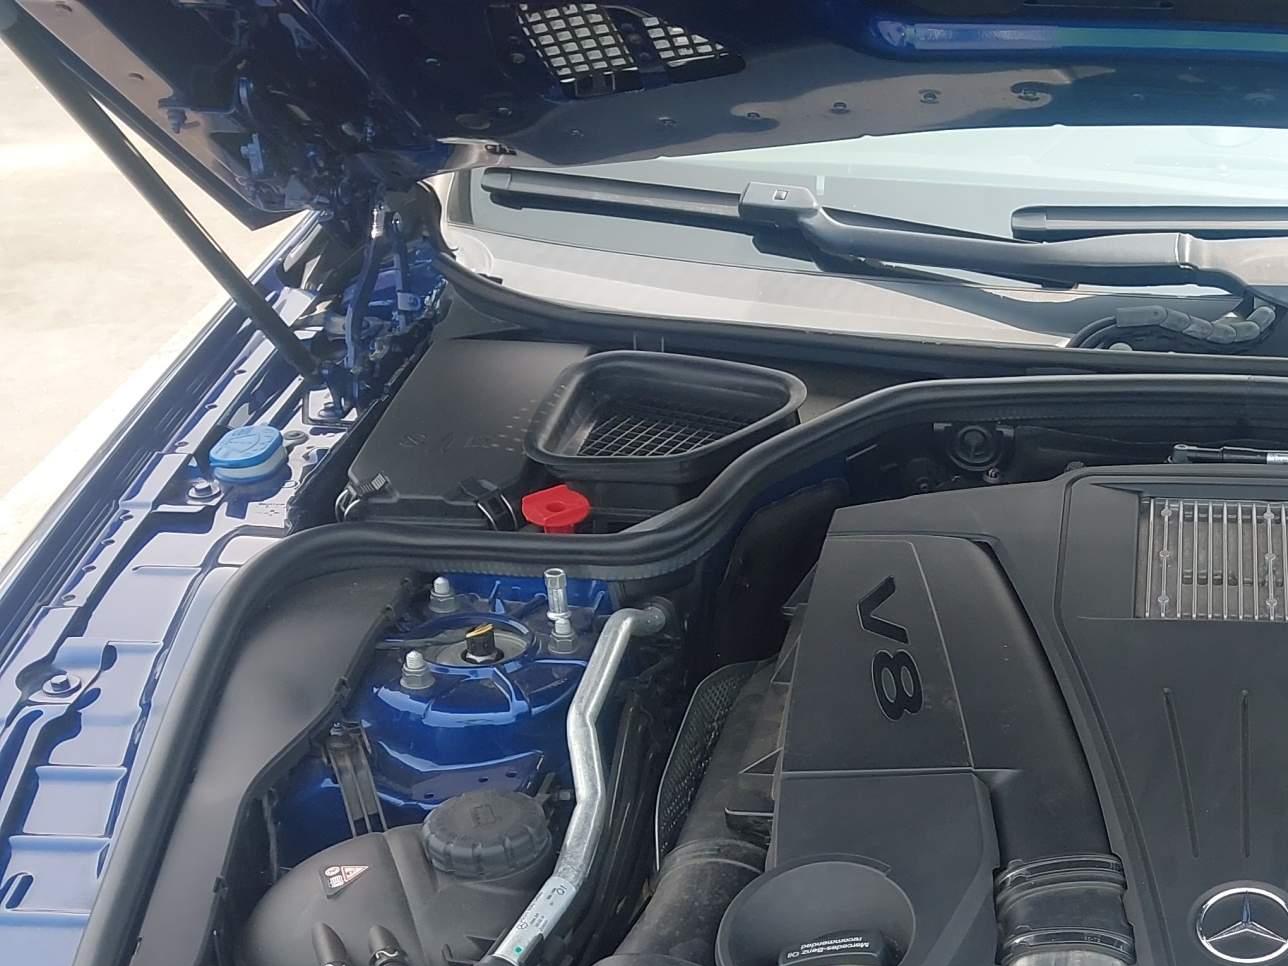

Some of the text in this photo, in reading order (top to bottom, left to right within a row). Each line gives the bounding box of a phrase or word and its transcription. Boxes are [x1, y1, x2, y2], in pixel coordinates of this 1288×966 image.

[857, 576, 925, 722] V8
[787, 942, 870, 959] Mercedes-Benz Oil
[800, 936, 863, 950] recommended
